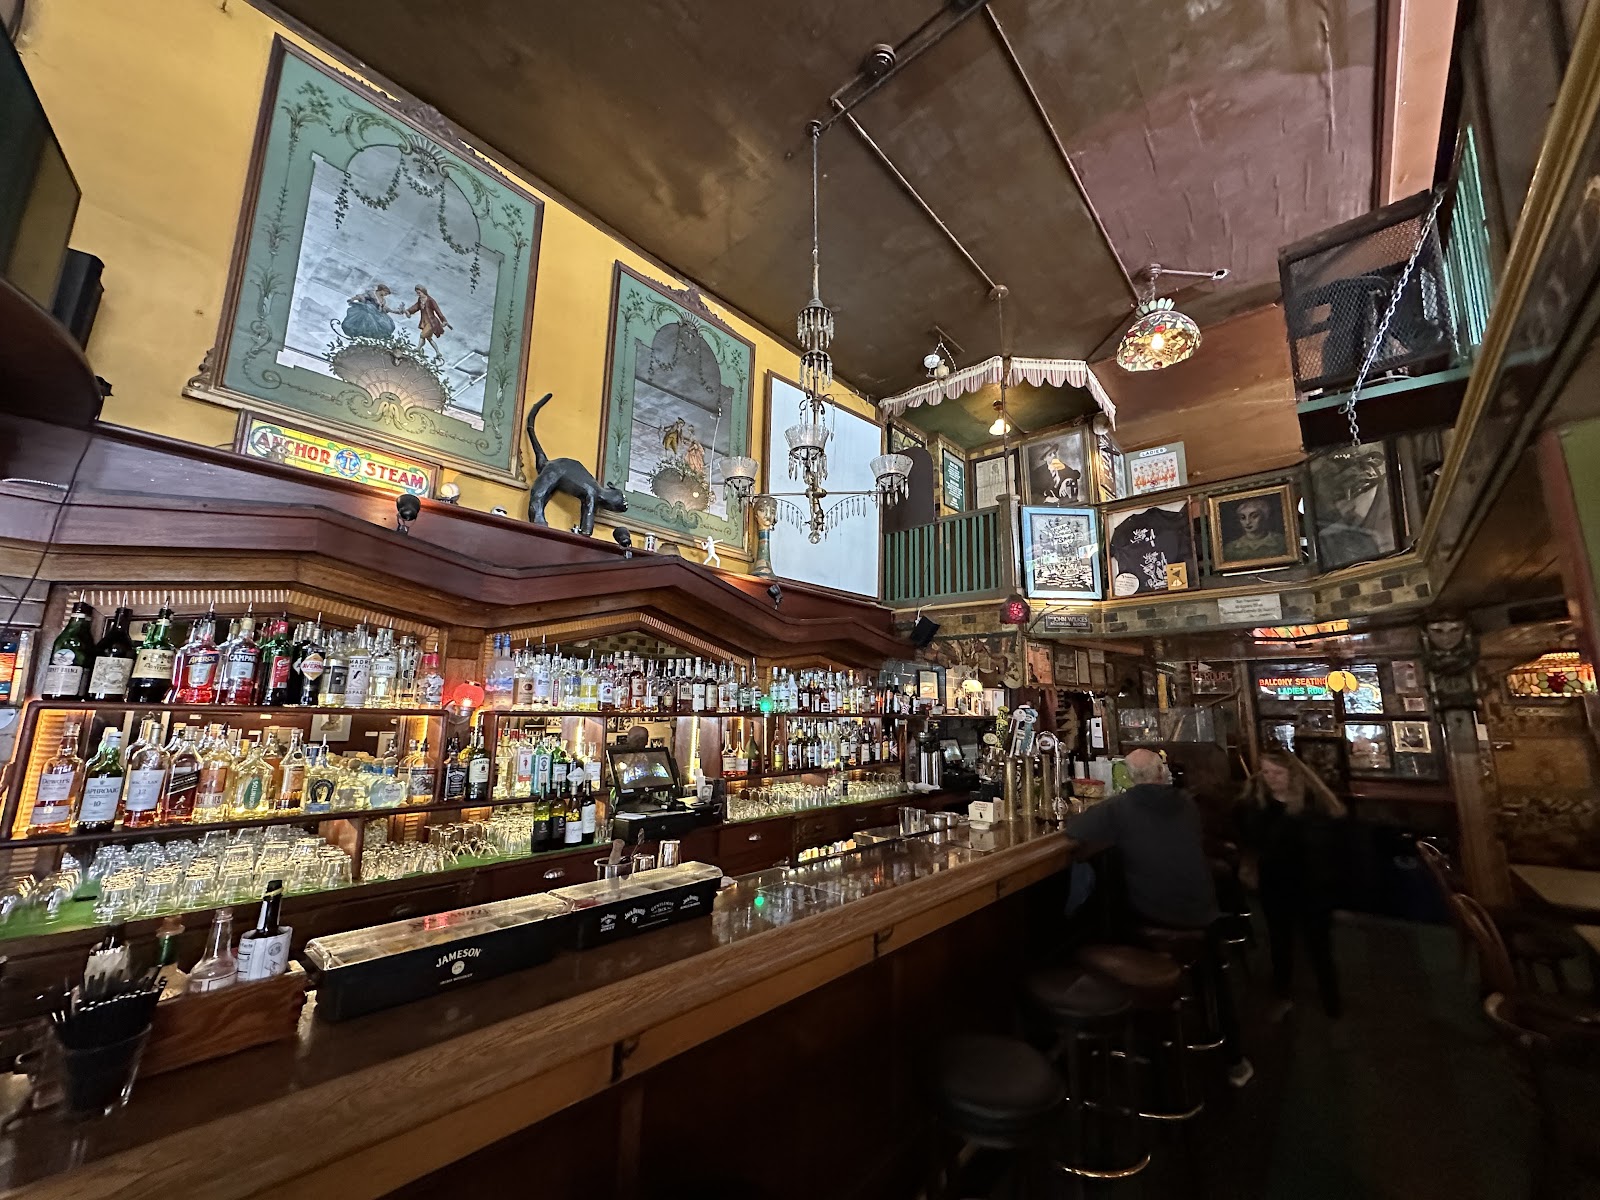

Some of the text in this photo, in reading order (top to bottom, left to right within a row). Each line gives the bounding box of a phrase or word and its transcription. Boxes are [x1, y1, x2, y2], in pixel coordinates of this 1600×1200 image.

[255, 432, 424, 490] ANCHOR STEAM
[188, 654, 216, 665] APEROL
[1259, 677, 1293, 687] BALCONY
[1277, 687, 1305, 696] LADIES
[93, 800, 102, 808] 10
[435, 947, 483, 968] JAMESON
